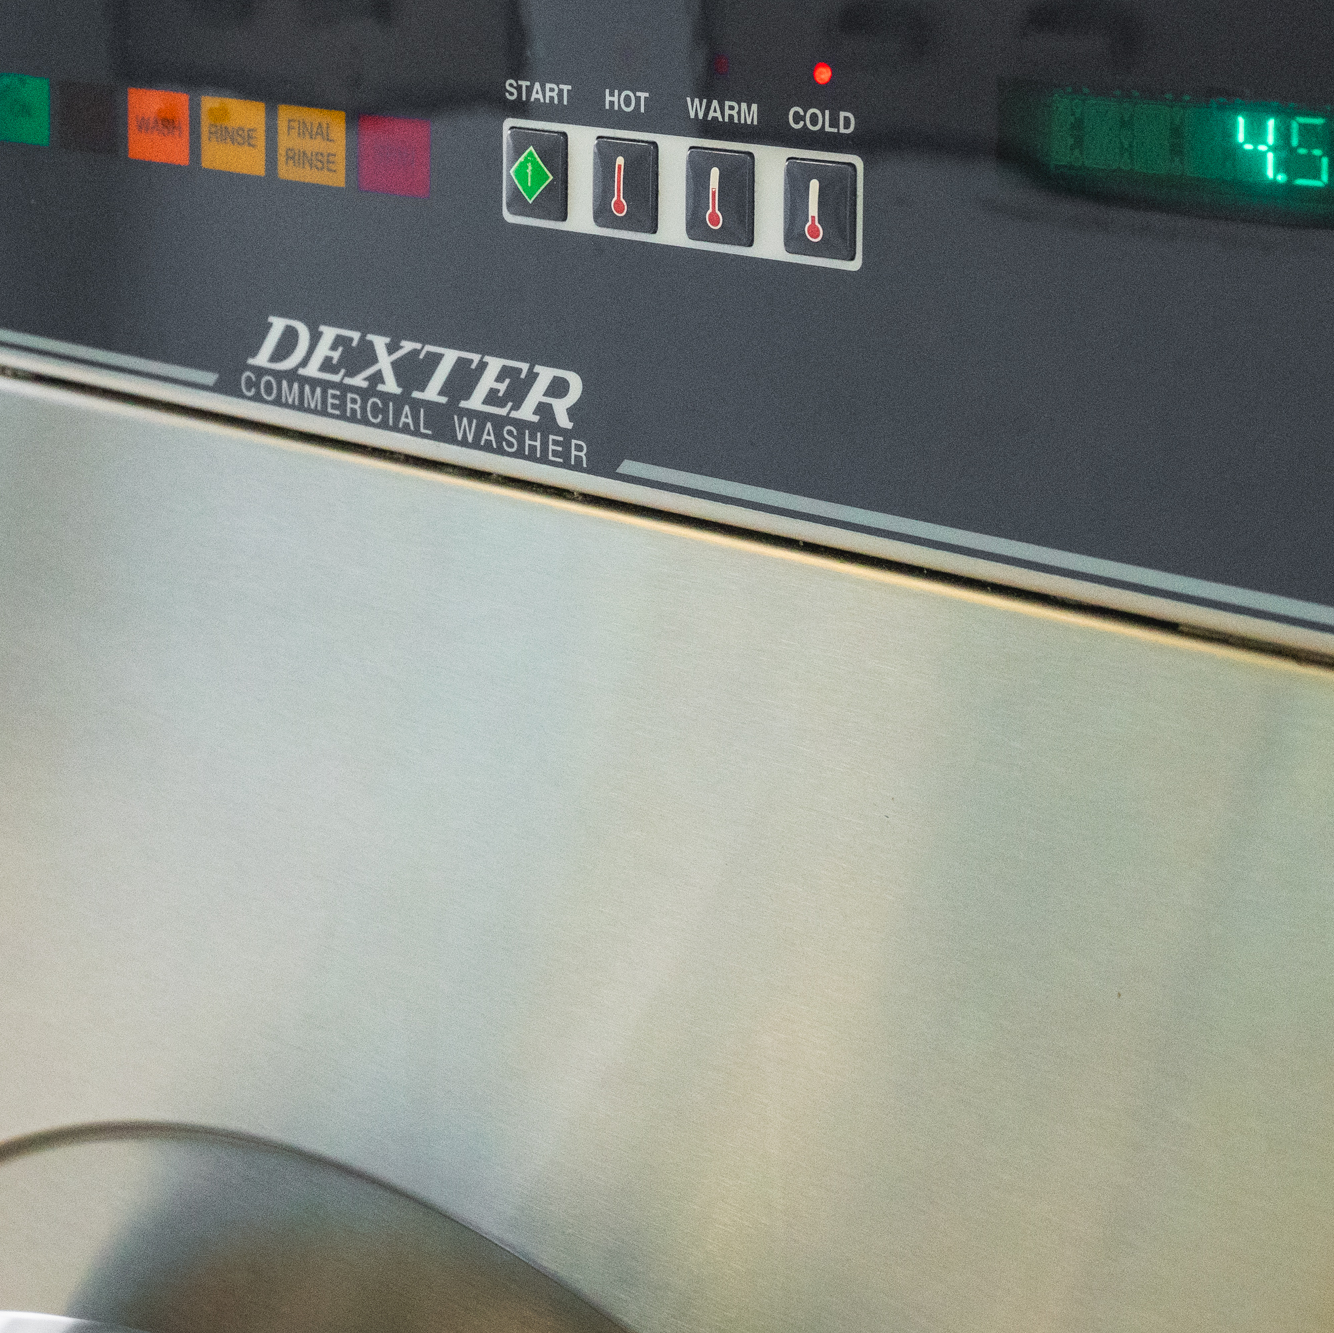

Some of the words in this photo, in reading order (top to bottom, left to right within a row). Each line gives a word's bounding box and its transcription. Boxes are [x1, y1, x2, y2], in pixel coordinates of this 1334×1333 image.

[505, 78, 572, 106] START
[604, 88, 649, 114] HOT
[686, 96, 759, 126] WARM
[788, 106, 856, 135] COLD
[136, 115, 183, 141] WASH
[207, 124, 258, 149] RINSE
[286, 118, 335, 145] FINAL
[285, 148, 337, 175] RINSE
[247, 316, 584, 429] DEXTER
[240, 370, 433, 436] COMMERCIAL
[453, 414, 589, 468] WASHER
